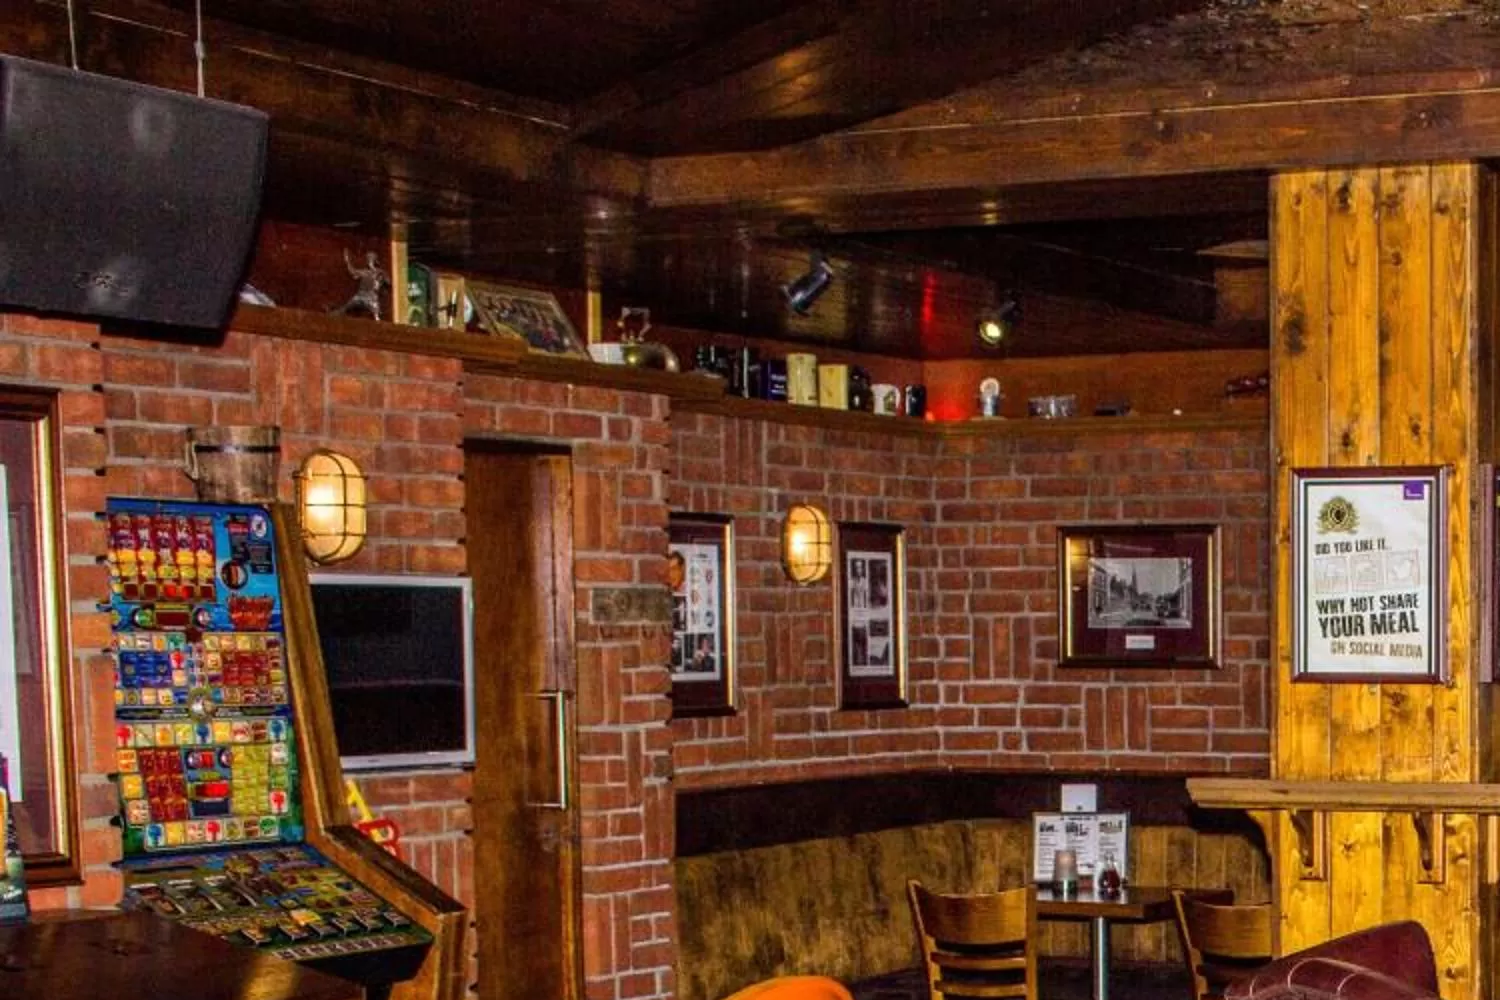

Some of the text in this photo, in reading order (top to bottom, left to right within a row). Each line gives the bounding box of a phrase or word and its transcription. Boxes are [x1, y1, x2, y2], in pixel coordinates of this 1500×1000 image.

[1334, 541, 1352, 553] YOU
[1355, 539, 1373, 552] LIKE
[1316, 593, 1419, 614] WHY NOT SHARE
[1318, 610, 1419, 638] YOUR MEAL
[1331, 641, 1423, 658] ON SOCIAL MEDIA
